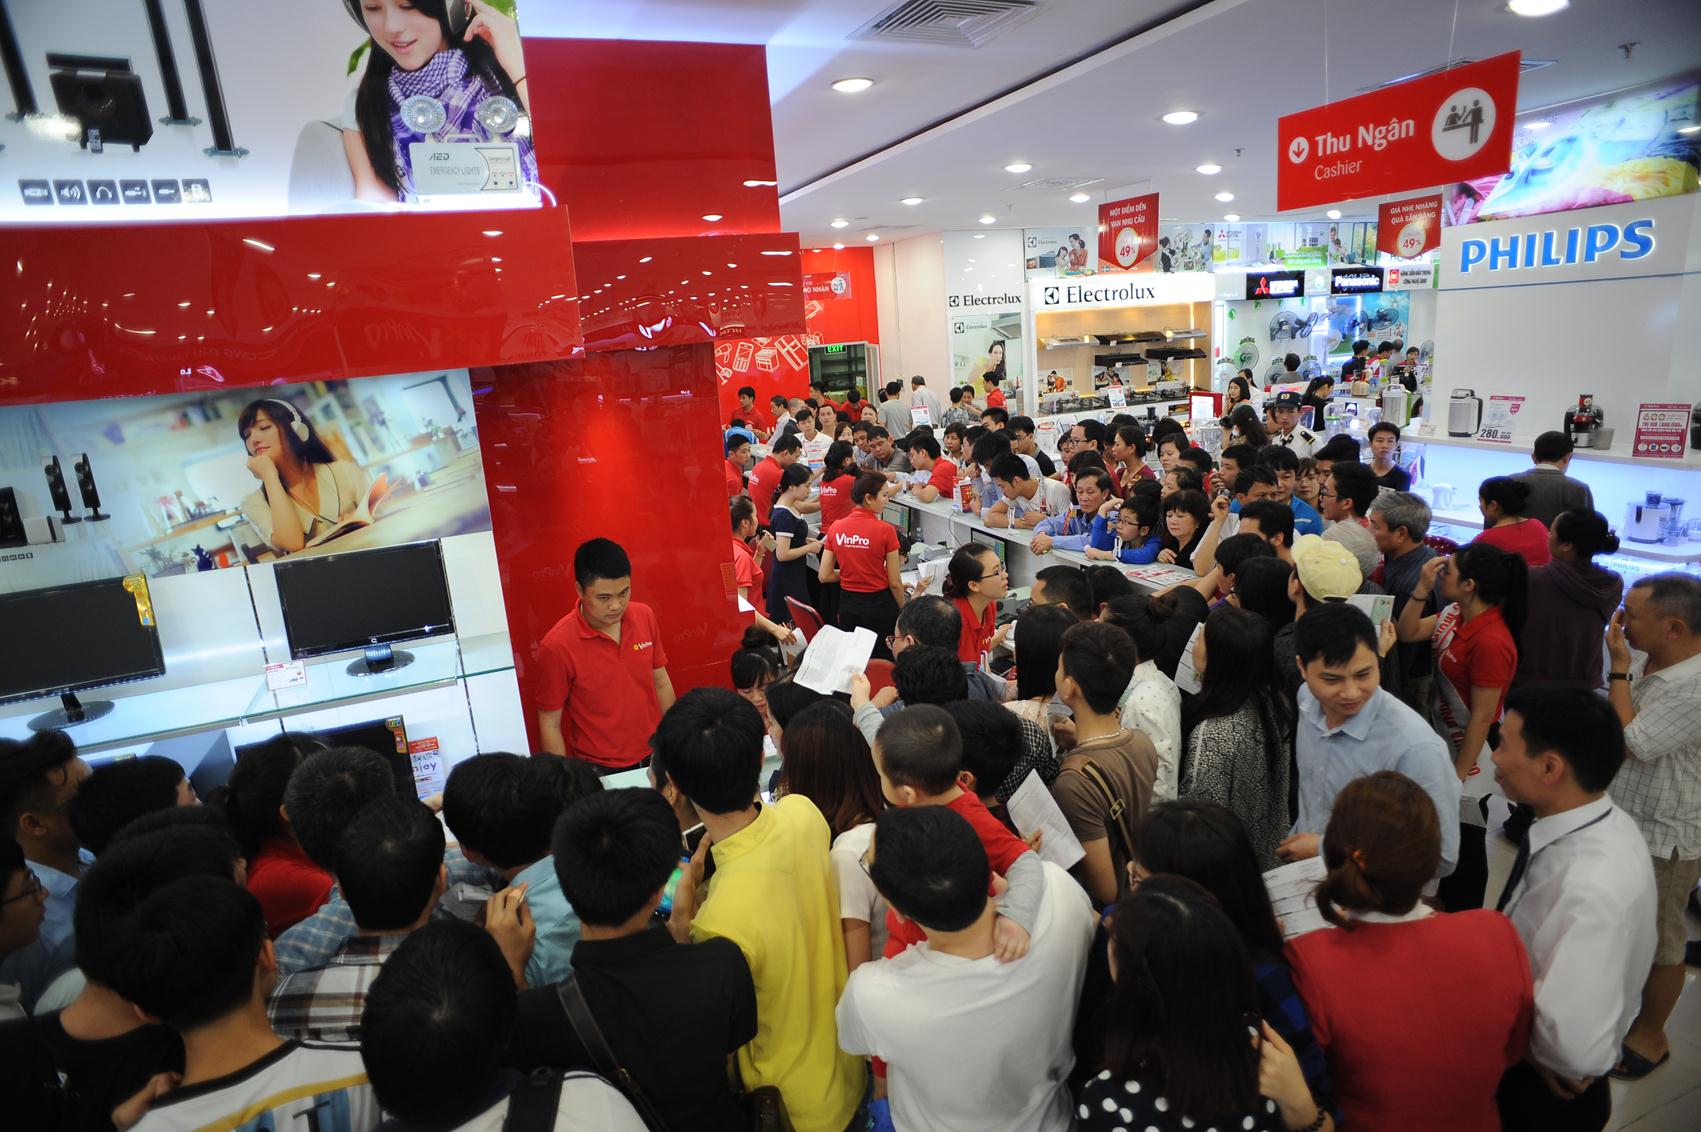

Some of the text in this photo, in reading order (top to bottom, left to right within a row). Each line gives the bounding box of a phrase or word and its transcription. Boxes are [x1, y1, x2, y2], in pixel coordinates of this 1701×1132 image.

[1315, 117, 1415, 157] Thu Ngân
[428, 152, 450, 161] AED
[1314, 160, 1363, 180] Cashier
[1460, 219, 1655, 273] PHILIPS
[1334, 274, 1380, 287] Panasonic
[963, 293, 1022, 306] Electrolux
[1067, 282, 1155, 304] Electrolux
[827, 344, 844, 353] EXIT
[835, 533, 870, 546] VinPro
